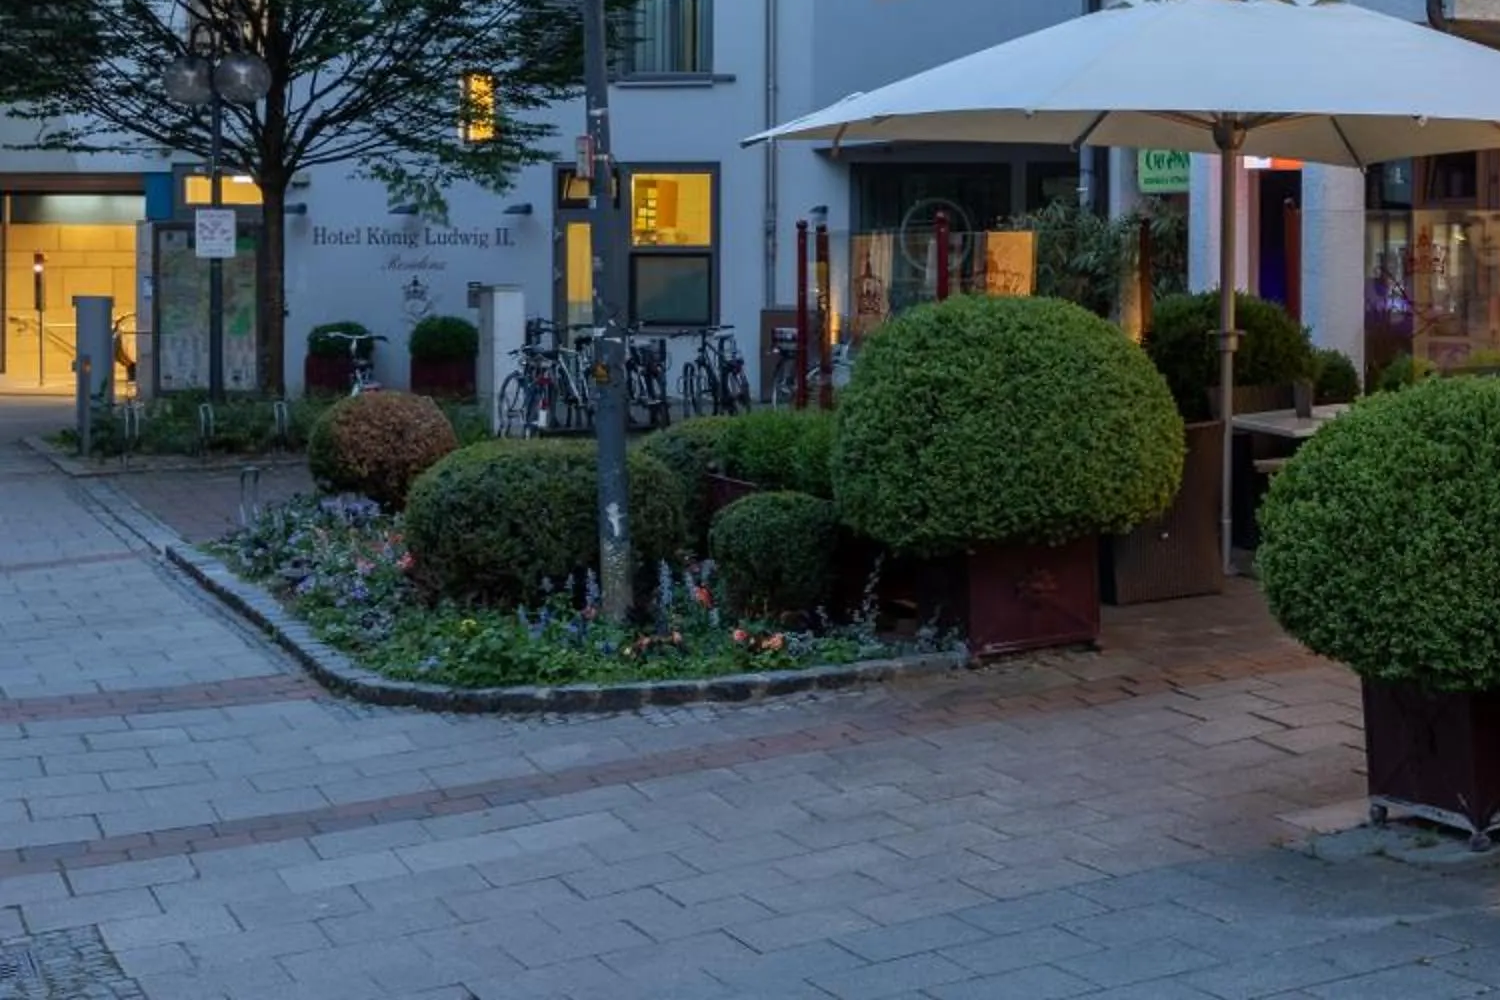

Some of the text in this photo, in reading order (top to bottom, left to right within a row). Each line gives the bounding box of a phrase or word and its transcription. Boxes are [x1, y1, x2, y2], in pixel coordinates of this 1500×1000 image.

[313, 226, 516, 249] Hotel König Ludwig II.
